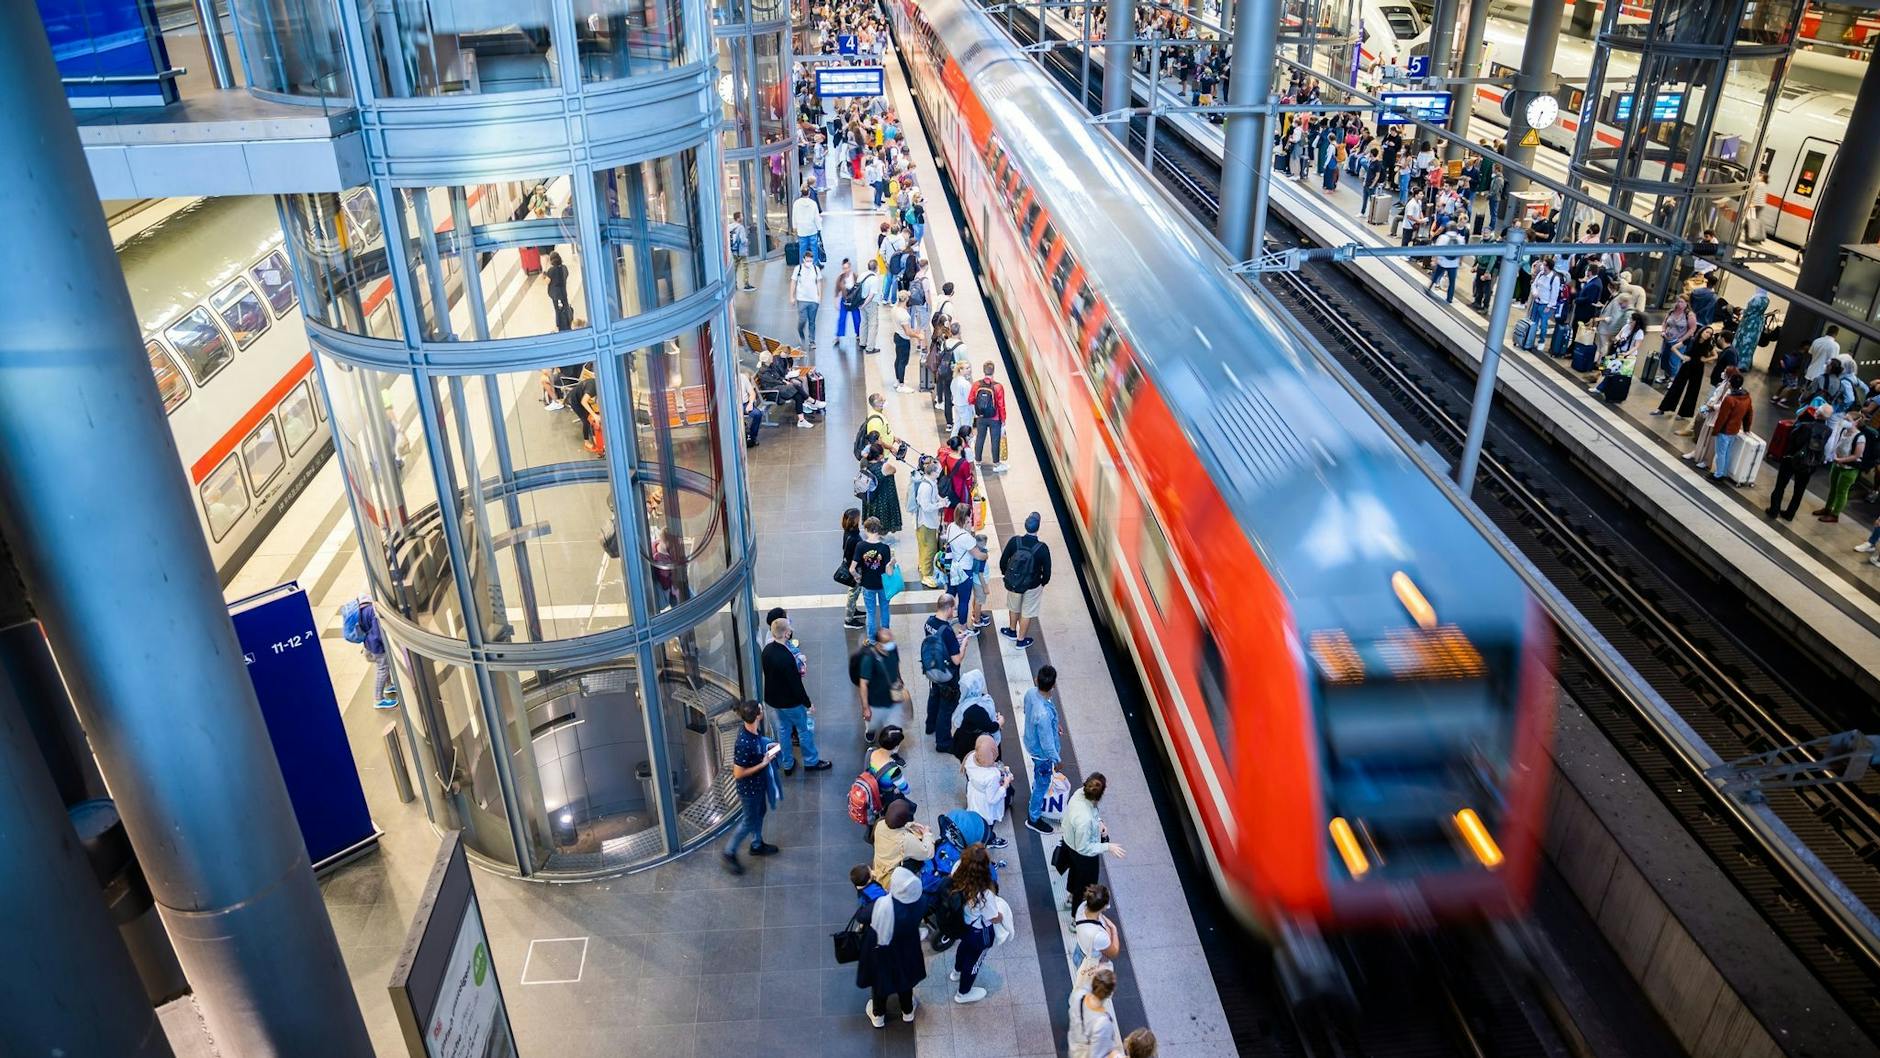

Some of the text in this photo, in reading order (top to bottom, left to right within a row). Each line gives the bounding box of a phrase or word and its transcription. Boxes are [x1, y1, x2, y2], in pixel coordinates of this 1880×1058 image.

[846, 36, 855, 50] 4
[1411, 57, 1421, 73] 5
[271, 635, 302, 655] 11-12
